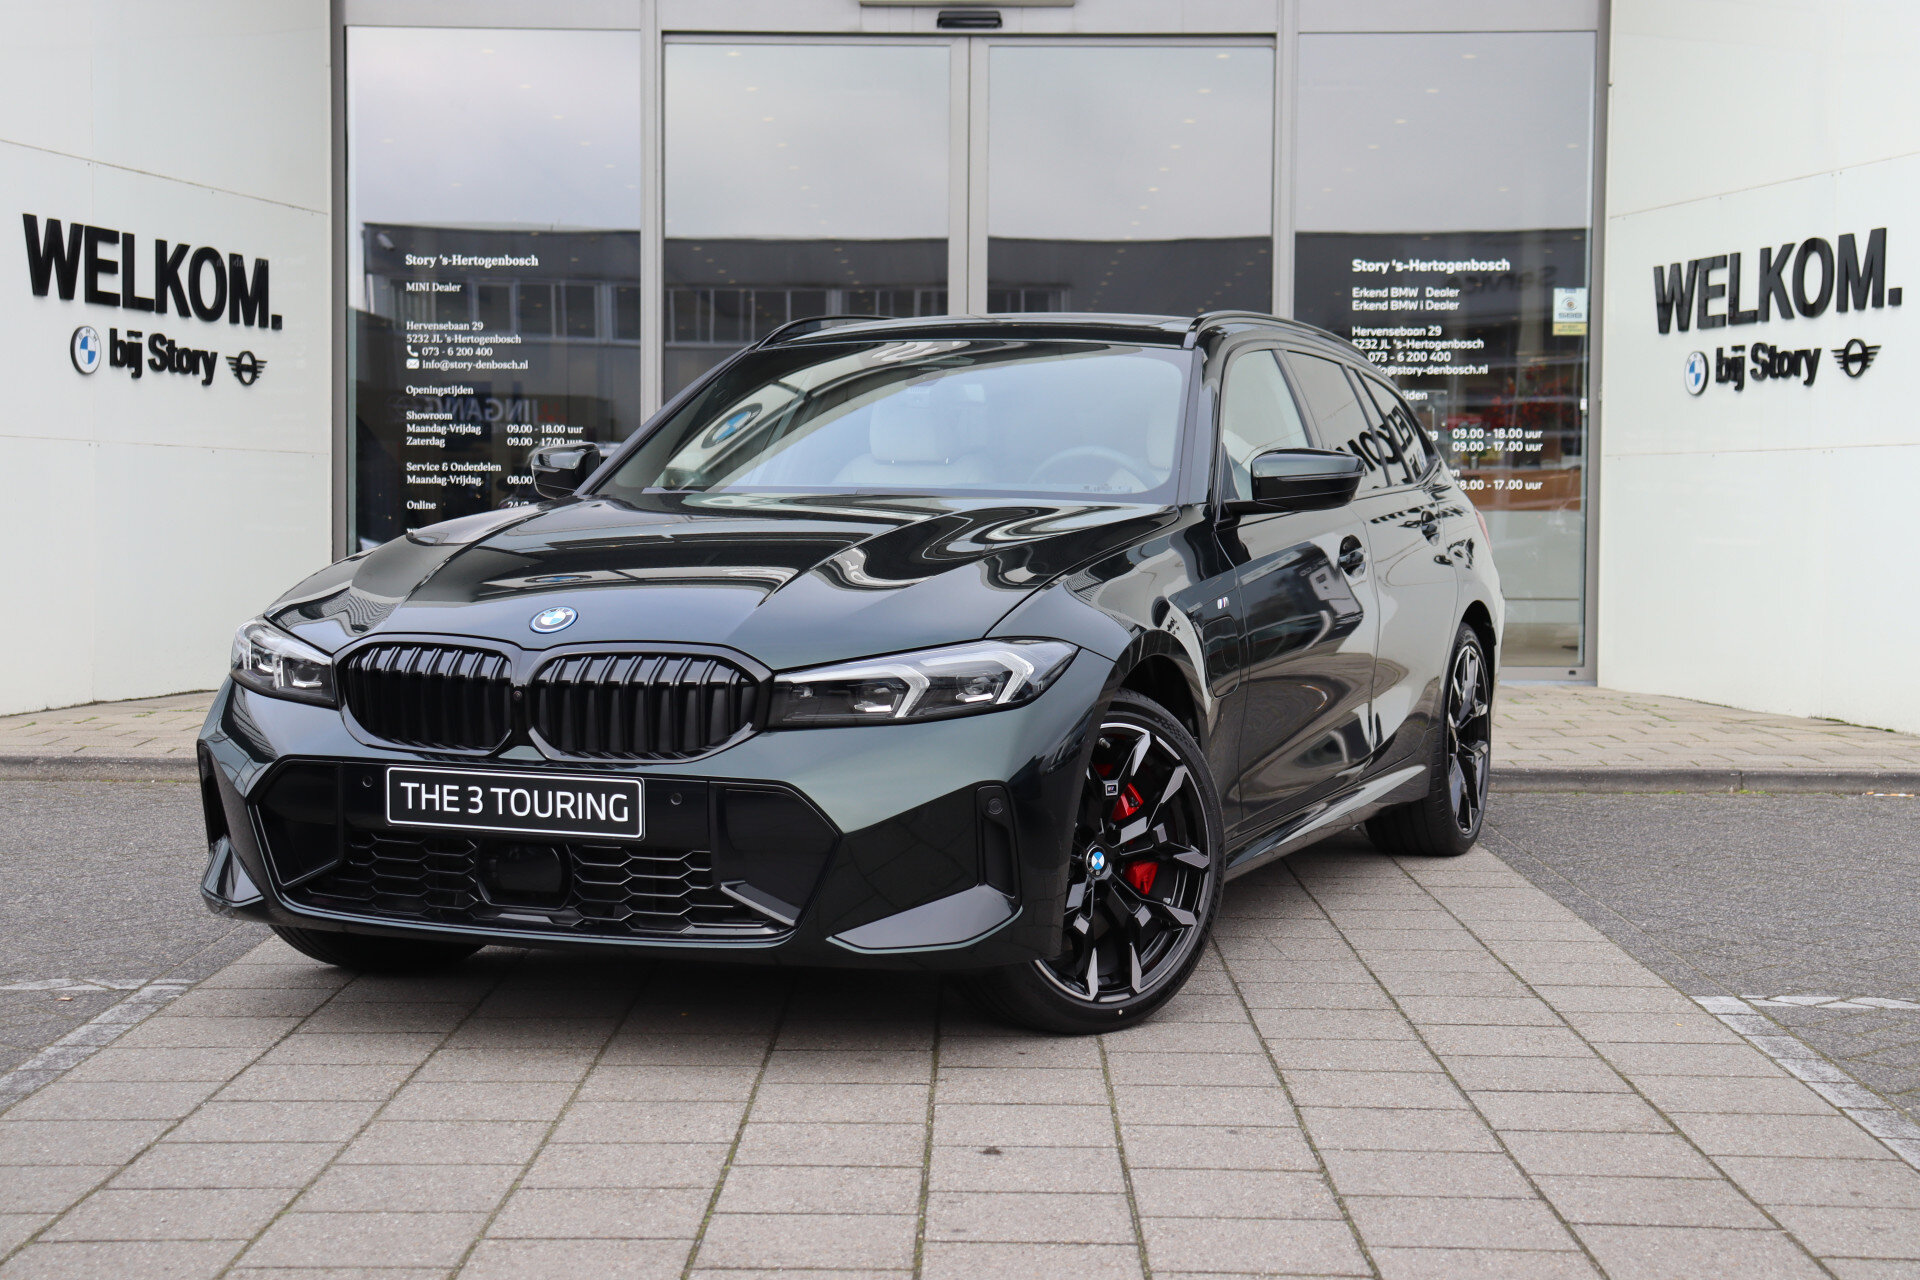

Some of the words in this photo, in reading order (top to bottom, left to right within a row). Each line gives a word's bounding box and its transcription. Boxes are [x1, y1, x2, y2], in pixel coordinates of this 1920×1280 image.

[405, 253, 437, 268] Story
[439, 253, 539, 269] 's-Hertogenbosch
[1352, 258, 1389, 275] Story
[1391, 257, 1511, 275] 's-Hertogenbosch
[22, 213, 282, 330] WELKOM.
[1653, 227, 1902, 334] WELKOM.
[406, 282, 429, 292] MINI
[432, 282, 462, 292] Dealer
[1352, 287, 1388, 298] Erkend
[1390, 287, 1418, 298] BMW
[1425, 287, 1460, 298] Dealer
[1352, 300, 1388, 311] Erkend
[1390, 300, 1418, 311] BMW
[1419, 301, 1424, 311] i
[1425, 300, 1460, 311] Dealer
[406, 321, 470, 331] Hervensebaan
[472, 321, 484, 331] 29
[1352, 325, 1427, 337] Hervensebaan
[1428, 326, 1442, 337] 29
[406, 334, 429, 344] 5232
[431, 334, 443, 344] JL
[444, 334, 522, 346] 's-Hertogenbosch
[1379, 339, 1392, 350] JL
[1393, 338, 1485, 350] 's-Hertogenbosch
[110, 328, 143, 379] bij
[148, 333, 218, 386] Story
[421, 347, 440, 357] 073
[447, 347, 454, 357] 6
[456, 347, 474, 357] 200
[475, 347, 493, 357] 400
[1367, 351, 1388, 363] 073
[1396, 351, 1405, 363] 6
[1406, 351, 1428, 363] 200
[1429, 351, 1452, 363] 400
[1377, 364, 1489, 378] o@story-denbosch.nl
[1715, 345, 1745, 391] bij
[1750, 342, 1822, 387] Story
[406, 385, 474, 397] Openingstijden
[406, 411, 453, 421] Showroom
[406, 423, 482, 435] Maandag-Vrijdag
[507, 424, 533, 434] 09.00
[541, 424, 566, 434] 18.00
[567, 426, 584, 434] uur
[1452, 428, 1485, 440] 09.00
[1493, 428, 1523, 440] 18.00
[1524, 430, 1543, 440] uur
[406, 436, 446, 448] Zaterdag
[507, 437, 533, 447] 09.00
[541, 437, 565, 447] 17.00
[1452, 441, 1485, 452] 09.00
[1493, 441, 1523, 452] 17.00
[1524, 443, 1543, 452] uur
[406, 462, 440, 472] Service
[441, 462, 449, 472] &
[450, 462, 502, 472] Onderdelen
[507, 475, 533, 485] 08.00
[1457, 479, 1485, 491] 8.00
[1493, 479, 1523, 491] 17.00
[1524, 482, 1543, 491] uur
[406, 500, 437, 510] Online
[400, 782, 460, 812] THE
[467, 786, 484, 814] 3
[490, 787, 629, 823] TOURING
